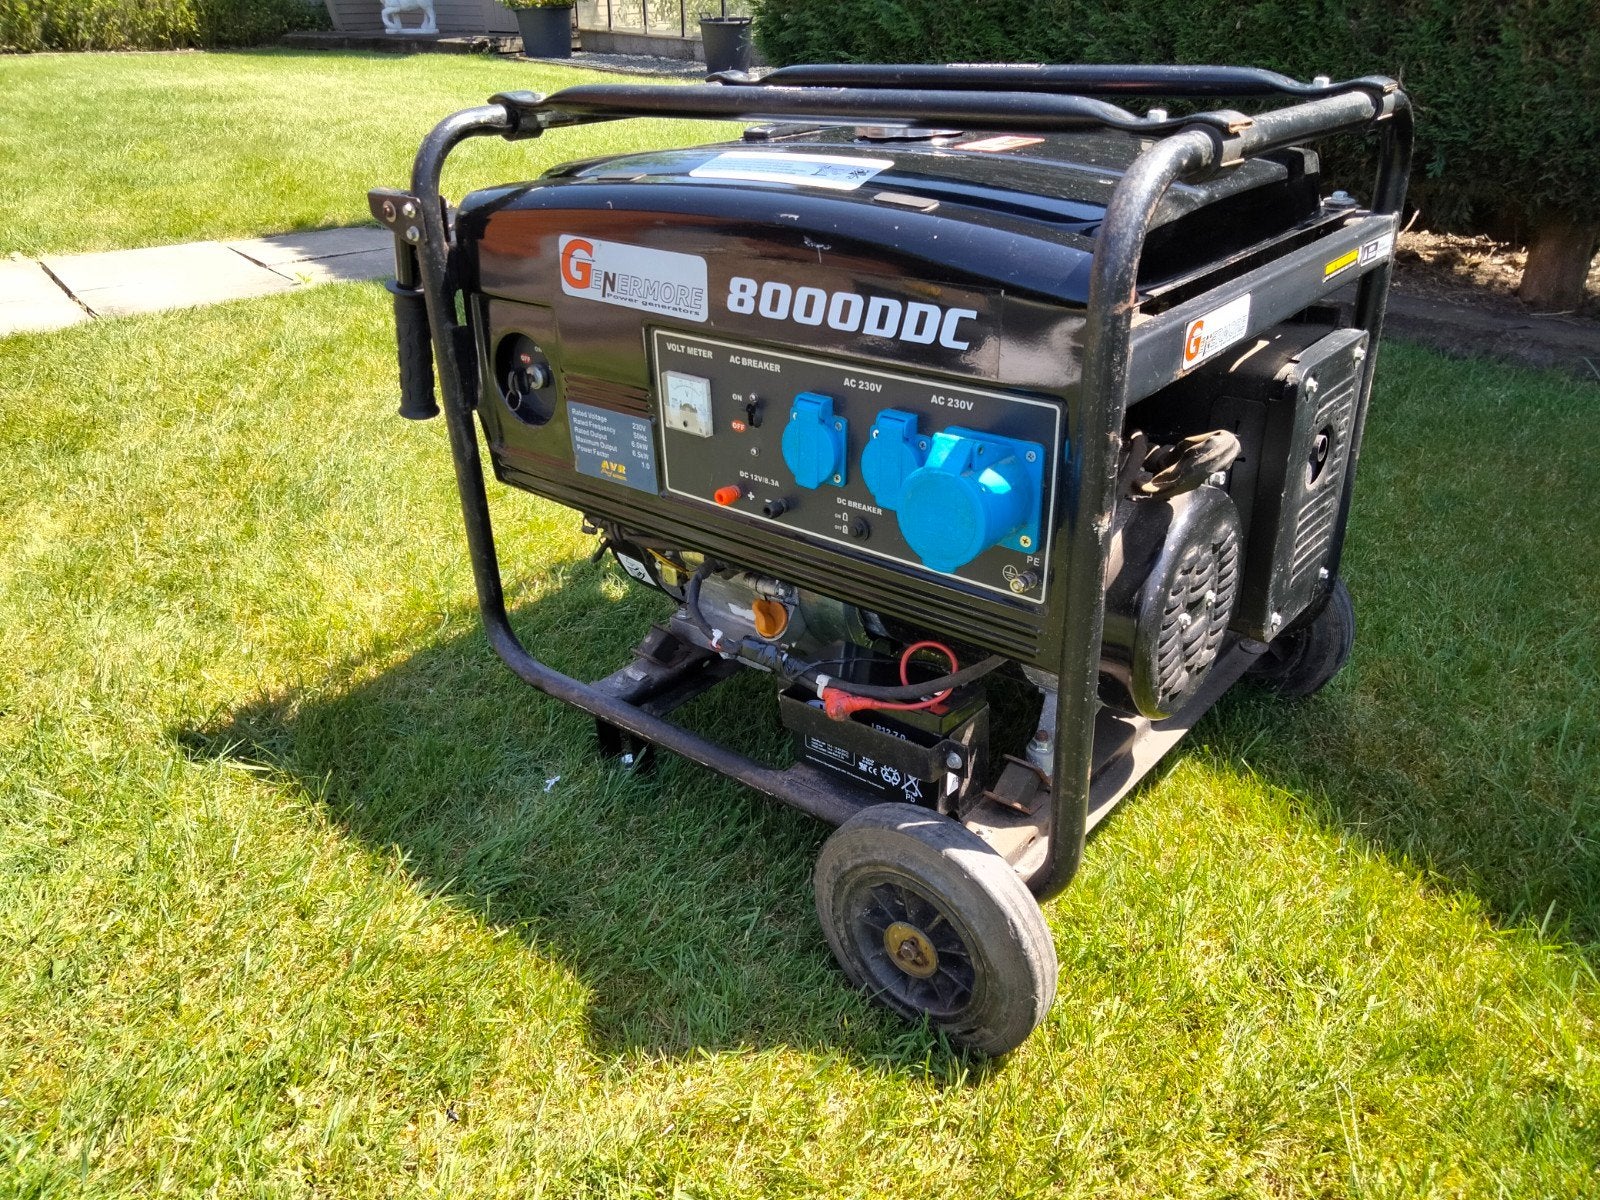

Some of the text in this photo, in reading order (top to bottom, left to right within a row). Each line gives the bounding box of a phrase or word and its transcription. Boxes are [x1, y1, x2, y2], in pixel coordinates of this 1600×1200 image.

[562, 239, 703, 309] GENERMORE
[606, 293, 700, 316] Power generators
[727, 277, 977, 350] 8000DDC
[667, 343, 713, 359] VOLT METER
[730, 355, 780, 372] AC BREAKER
[844, 378, 882, 392] AC 230V
[732, 393, 742, 402] ON
[931, 395, 974, 410] AC 230V
[572, 408, 587, 417] Rated
[573, 417, 588, 426] Rated
[732, 422, 745, 430] OFF
[574, 426, 589, 435] Rated
[602, 460, 626, 474] AVR
[750, 473, 779, 487] 12V/8.3A
[837, 497, 882, 515] DC BREAKER
[1026, 556, 1039, 566] PE
[906, 793, 916, 802] Pb
